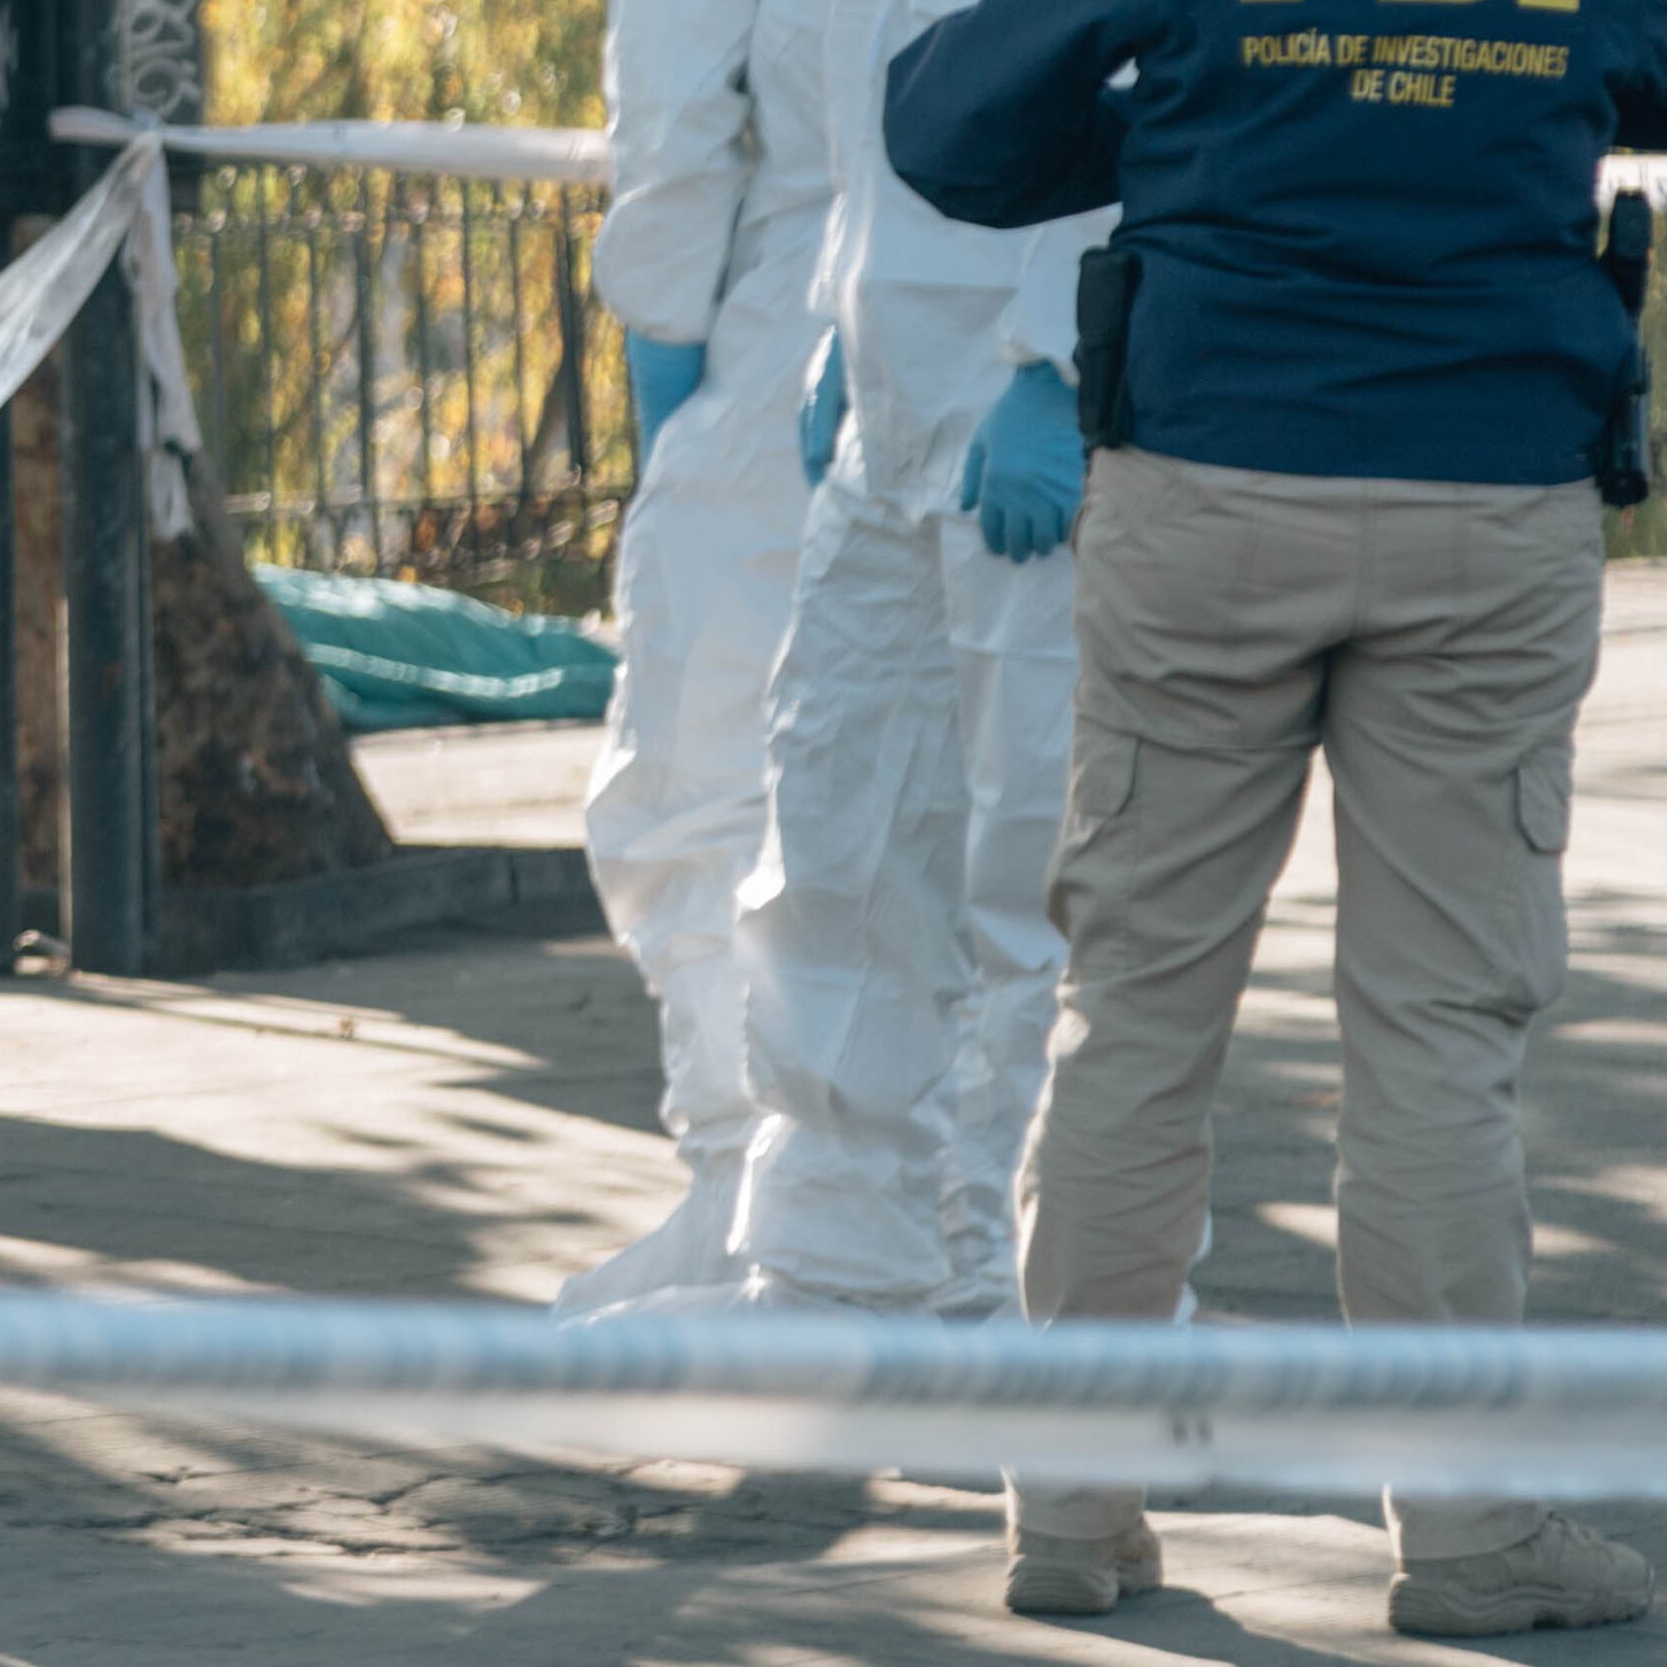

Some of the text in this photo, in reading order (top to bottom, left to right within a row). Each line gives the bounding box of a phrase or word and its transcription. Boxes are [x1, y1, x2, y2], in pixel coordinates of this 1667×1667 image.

[1243, 28, 1569, 79] POLICÍA DE INVESTIGACIONES
[1351, 69, 1456, 107] DE CHILE
